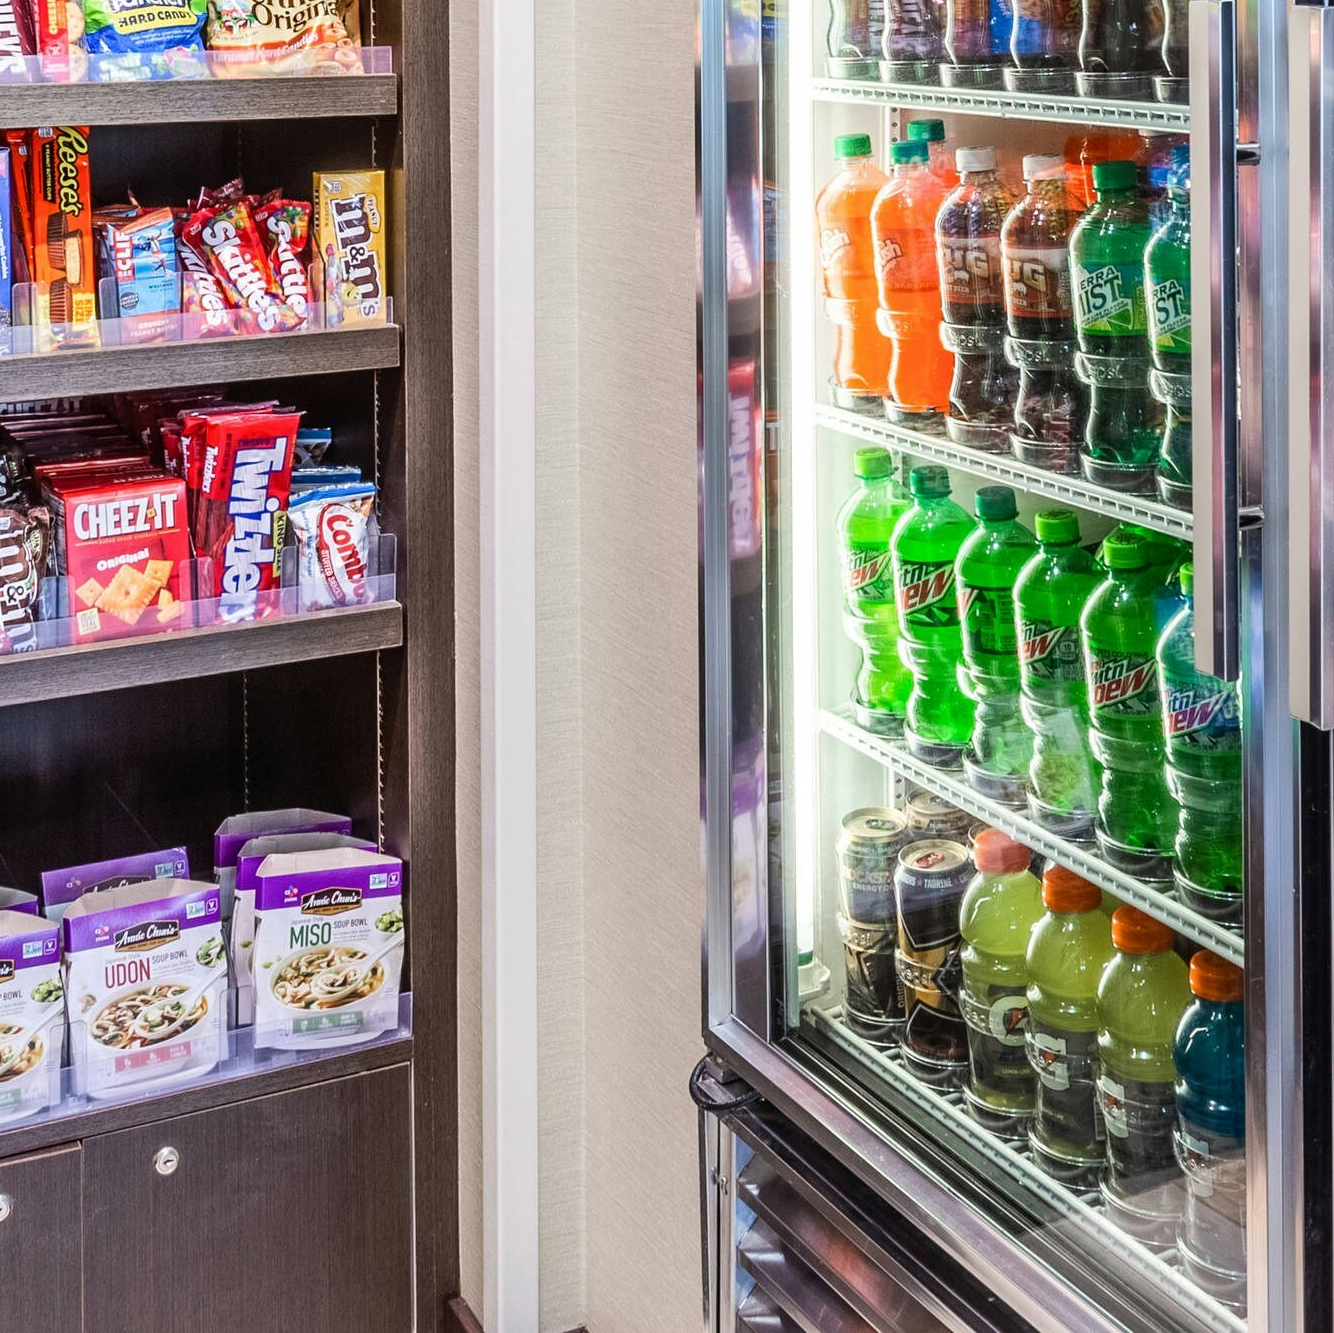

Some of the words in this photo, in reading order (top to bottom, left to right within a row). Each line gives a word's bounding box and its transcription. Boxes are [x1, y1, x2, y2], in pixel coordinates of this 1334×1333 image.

[119, 12, 156, 28] HARD
[202, 221, 279, 331] Skittles
[1080, 267, 1115, 290] ERRA
[1080, 274, 1119, 316] IST
[105, 958, 151, 989] UDON
[152, 955, 169, 964] SOUP
[171, 950, 188, 961] BOWL
